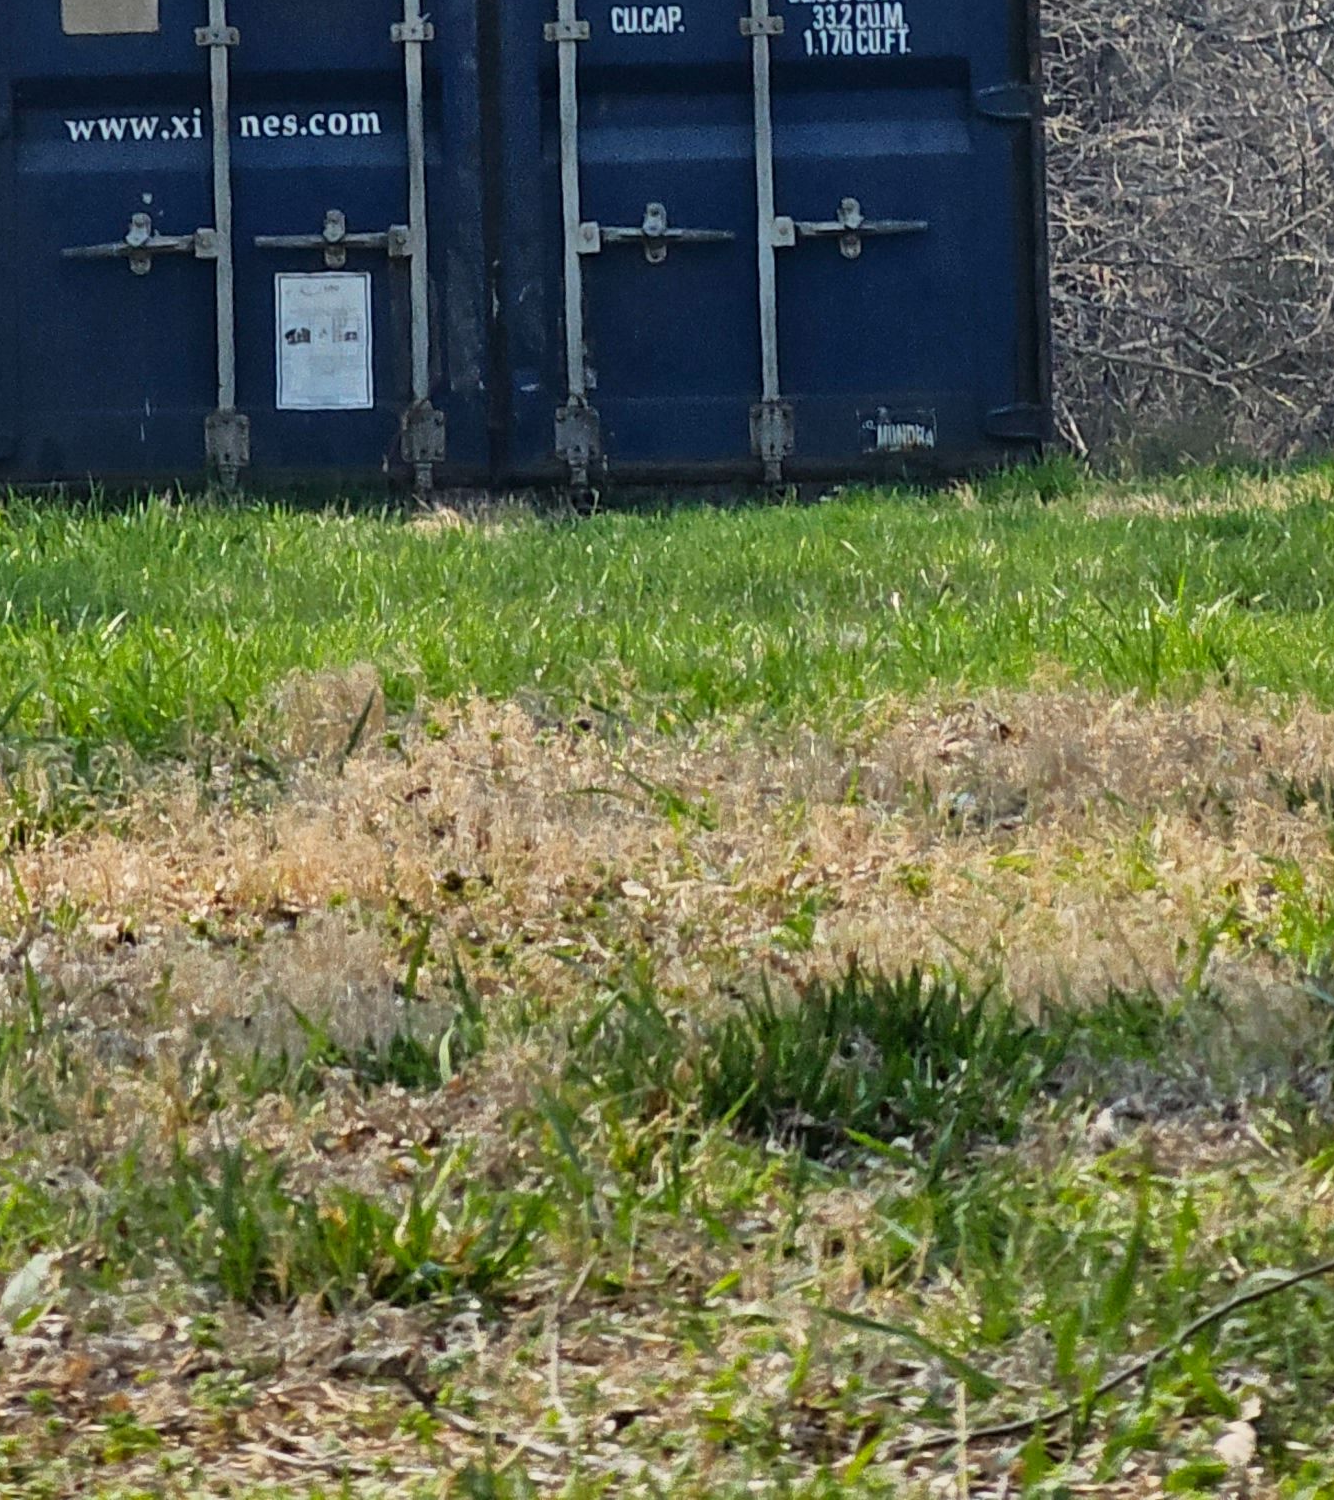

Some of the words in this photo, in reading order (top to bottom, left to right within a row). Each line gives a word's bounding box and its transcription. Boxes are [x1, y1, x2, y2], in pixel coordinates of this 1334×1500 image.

[610, 5, 686, 34] CU.CAP.
[812, 3, 853, 30] 33.2
[803, 28, 854, 56] 1.170
